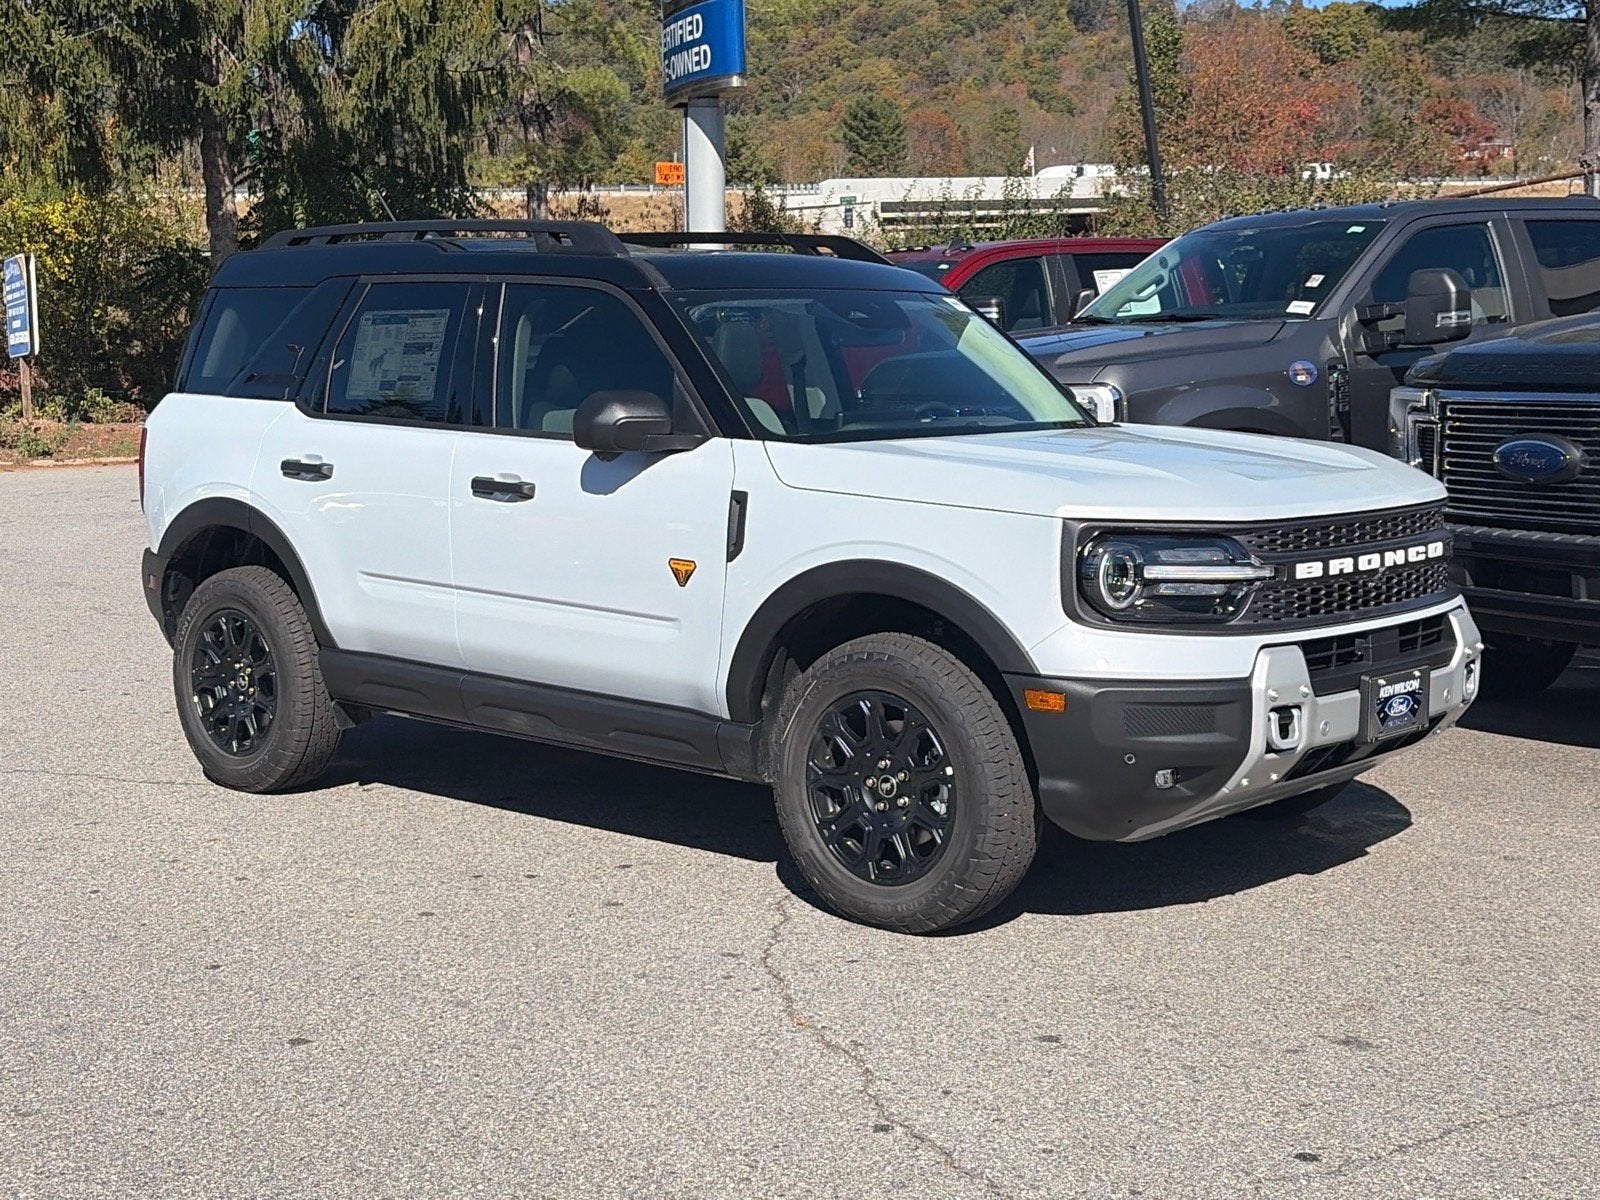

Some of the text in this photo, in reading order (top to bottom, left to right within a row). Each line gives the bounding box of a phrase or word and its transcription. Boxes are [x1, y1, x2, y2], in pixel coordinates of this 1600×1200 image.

[1295, 541, 1444, 580] BRONCO
[1380, 678, 1421, 698] KEN WILSON
[1390, 698, 1408, 714] Ford
